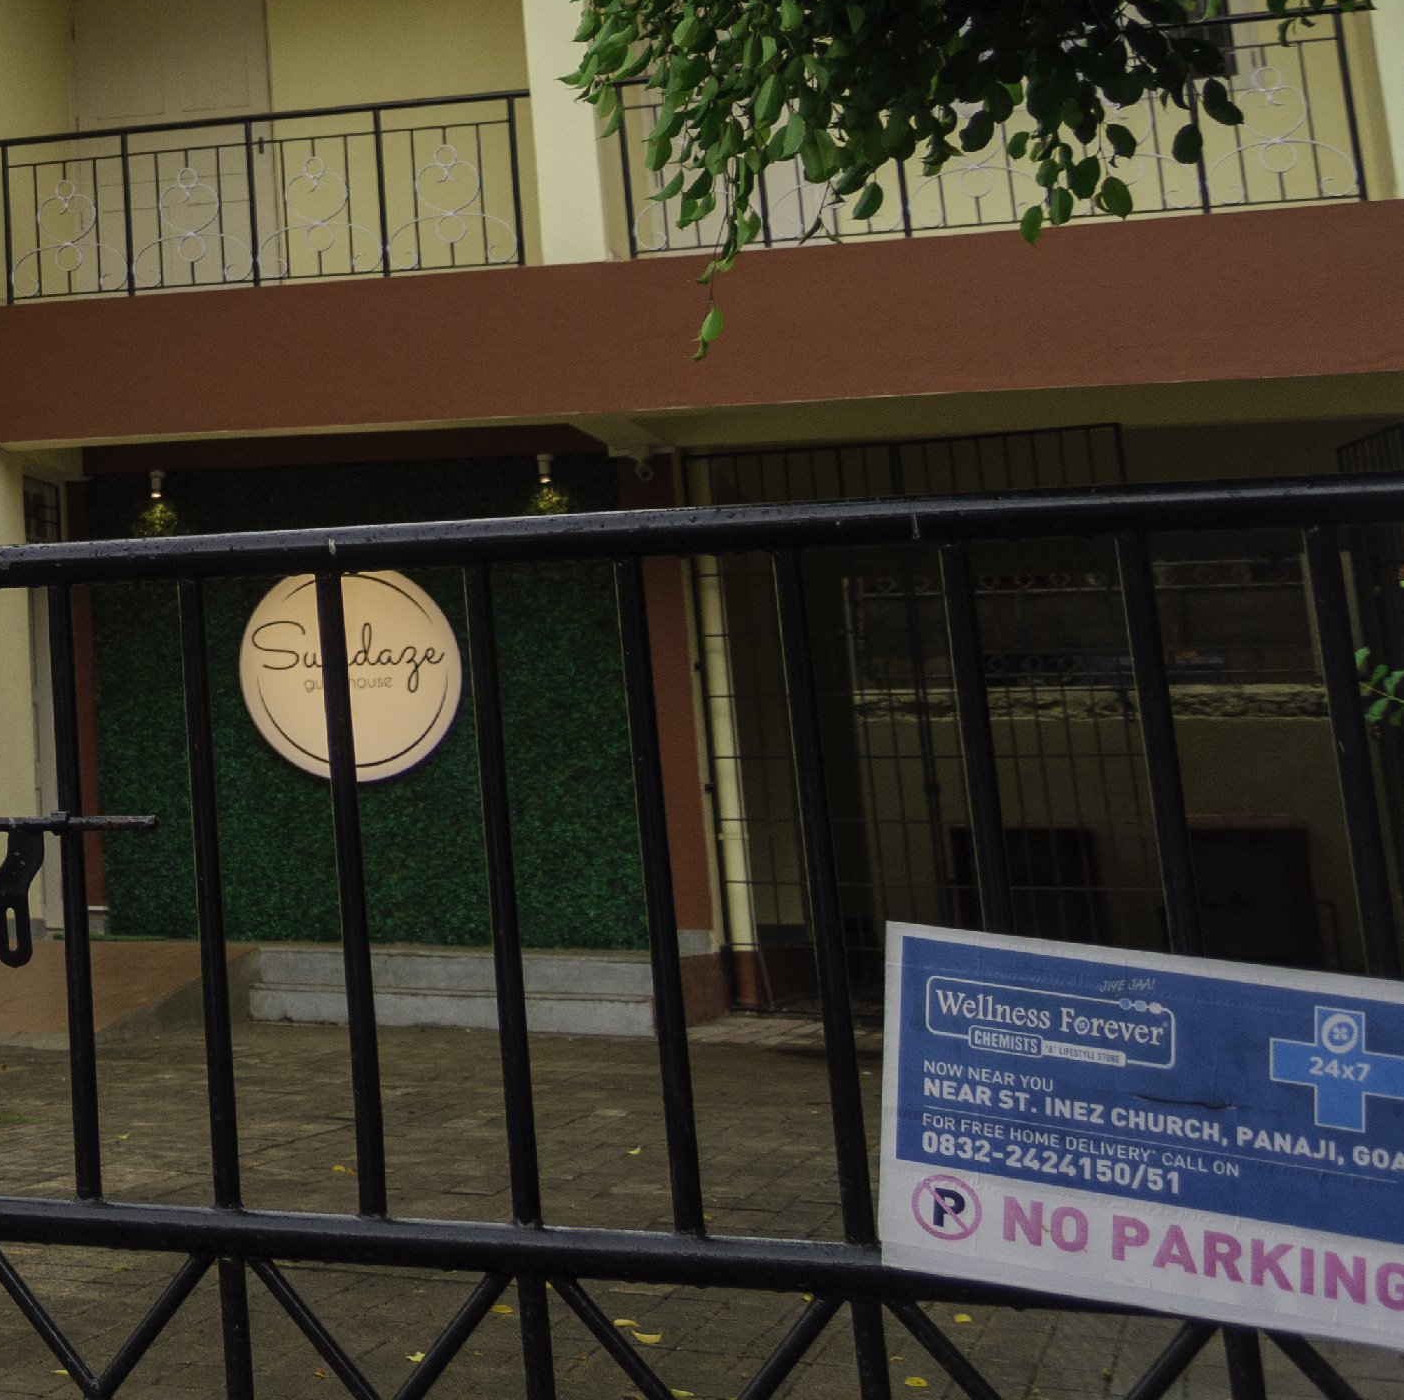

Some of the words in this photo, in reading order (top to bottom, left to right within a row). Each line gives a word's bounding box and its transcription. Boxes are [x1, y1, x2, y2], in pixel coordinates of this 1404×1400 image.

[252, 620, 446, 693] Sudaze
[935, 989, 1051, 1029] Wellness
[1060, 1007, 1164, 1045] Forever
[973, 1029, 1039, 1054] CHEMISTS
[1097, 1052, 1121, 1064] STORE
[923, 1059, 963, 1078] NOW
[968, 1066, 1015, 1088] NEAR
[1021, 1075, 1054, 1093] YOU
[1309, 1056, 1371, 1082] 24x7
[922, 1112, 955, 1131] FOR
[960, 1119, 1004, 1139] FREE
[1009, 1126, 1060, 1149] HOME
[1162, 1151, 1208, 1173] CALL
[1213, 1160, 1239, 1177] ON
[923, 1077, 992, 1107] NEAR
[998, 1089, 1038, 1114] ST.
[1045, 1096, 1104, 1124] INEZ
[1110, 1107, 1229, 1146] CHURCH,
[1237, 1126, 1345, 1166] PANAJI,
[1352, 1145, 1404, 1172] GOA
[921, 1131, 1179, 1194] 0832-2424150/51
[1002, 1195, 1089, 1253] NO
[1111, 1214, 1404, 1312] PARKING
